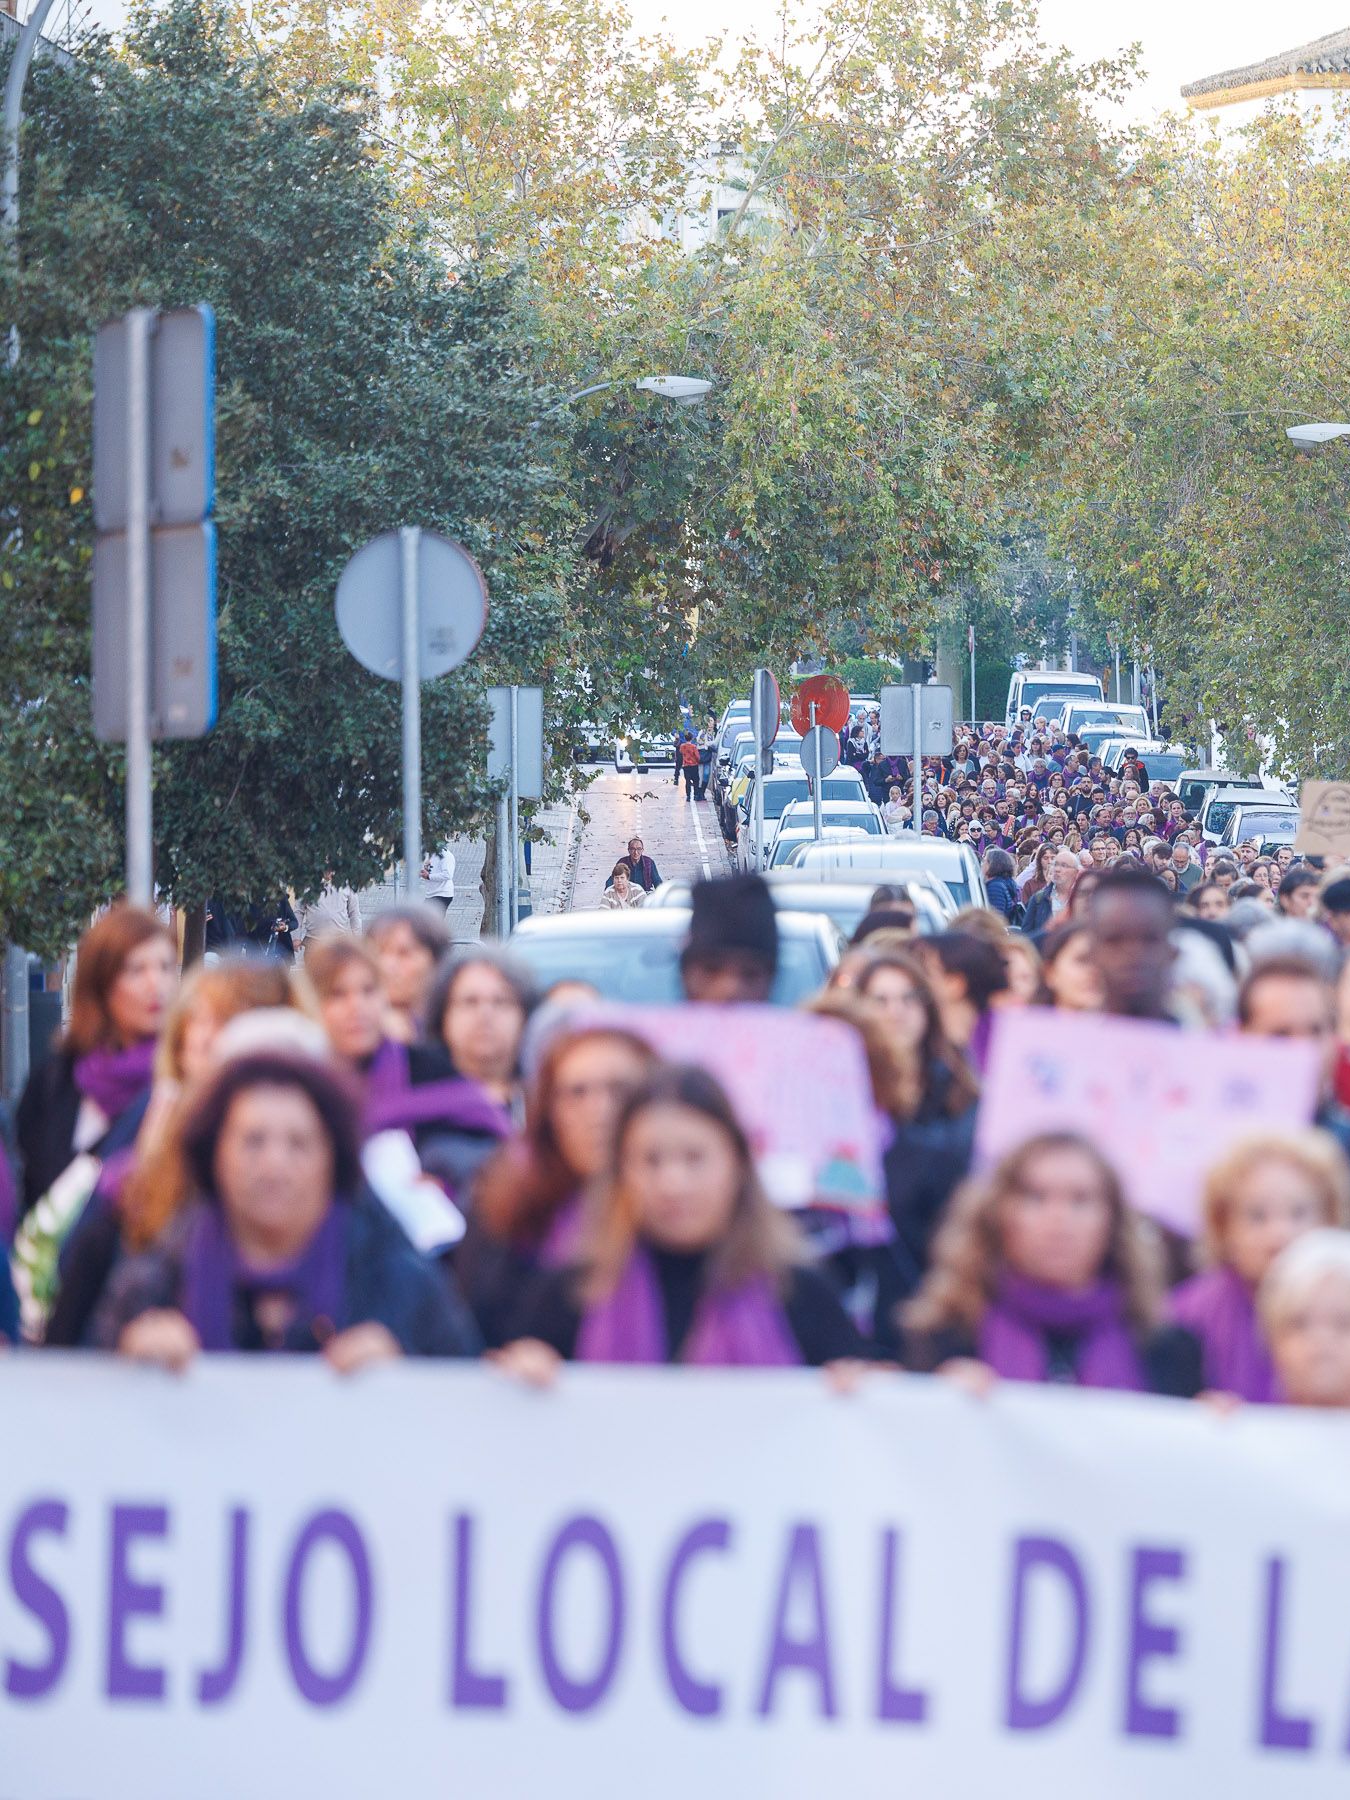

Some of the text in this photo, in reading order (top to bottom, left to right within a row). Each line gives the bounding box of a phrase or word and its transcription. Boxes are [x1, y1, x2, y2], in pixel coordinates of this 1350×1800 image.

[2, 1497, 374, 1708] SEJO
[449, 1511, 930, 1725] LOCAL
[1003, 1533, 1187, 1740] DE
